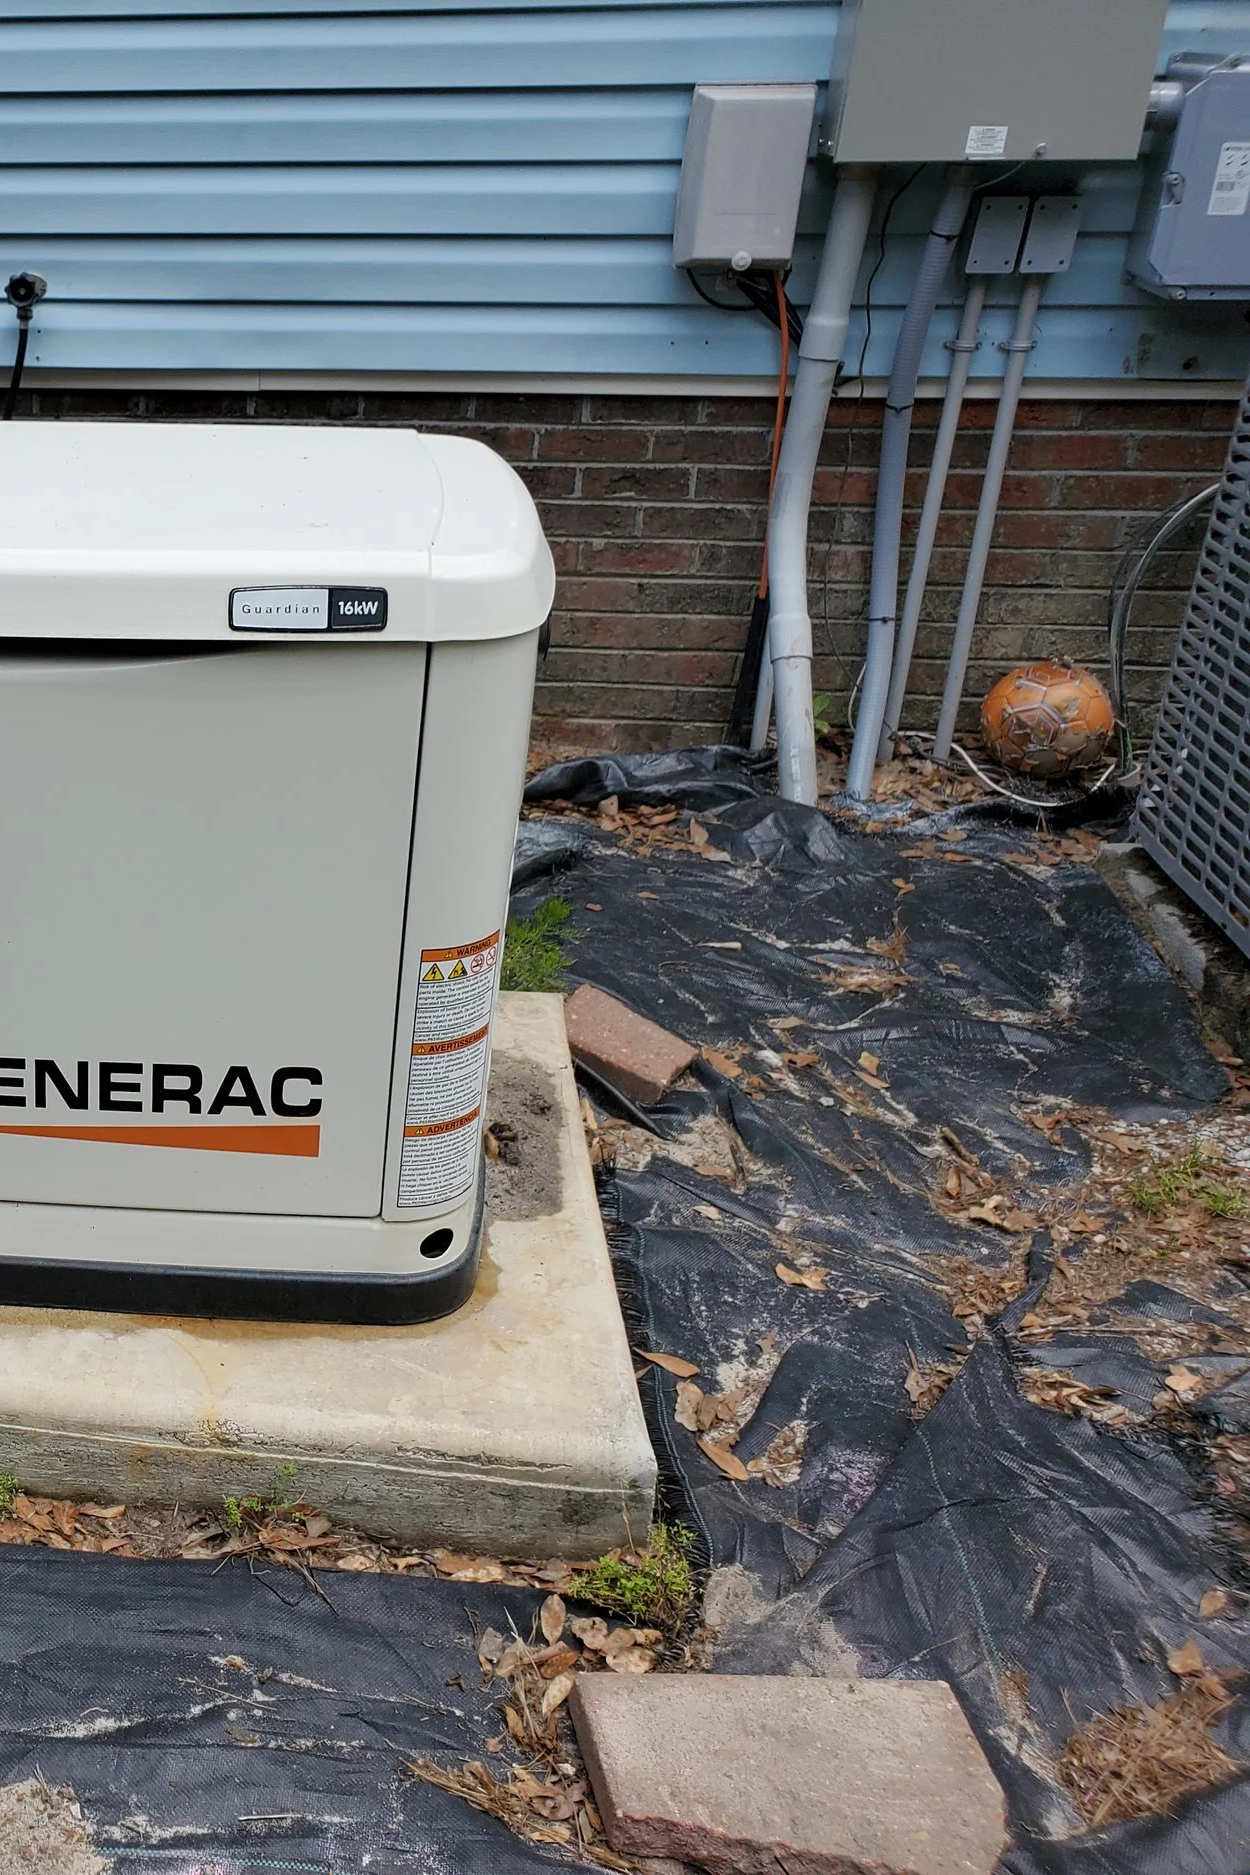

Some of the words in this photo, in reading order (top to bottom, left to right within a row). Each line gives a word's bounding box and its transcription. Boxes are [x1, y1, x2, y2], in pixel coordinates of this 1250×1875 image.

[242, 604, 320, 614] Guardian
[338, 601, 379, 616] 16kW
[457, 939, 491, 957] WARNING
